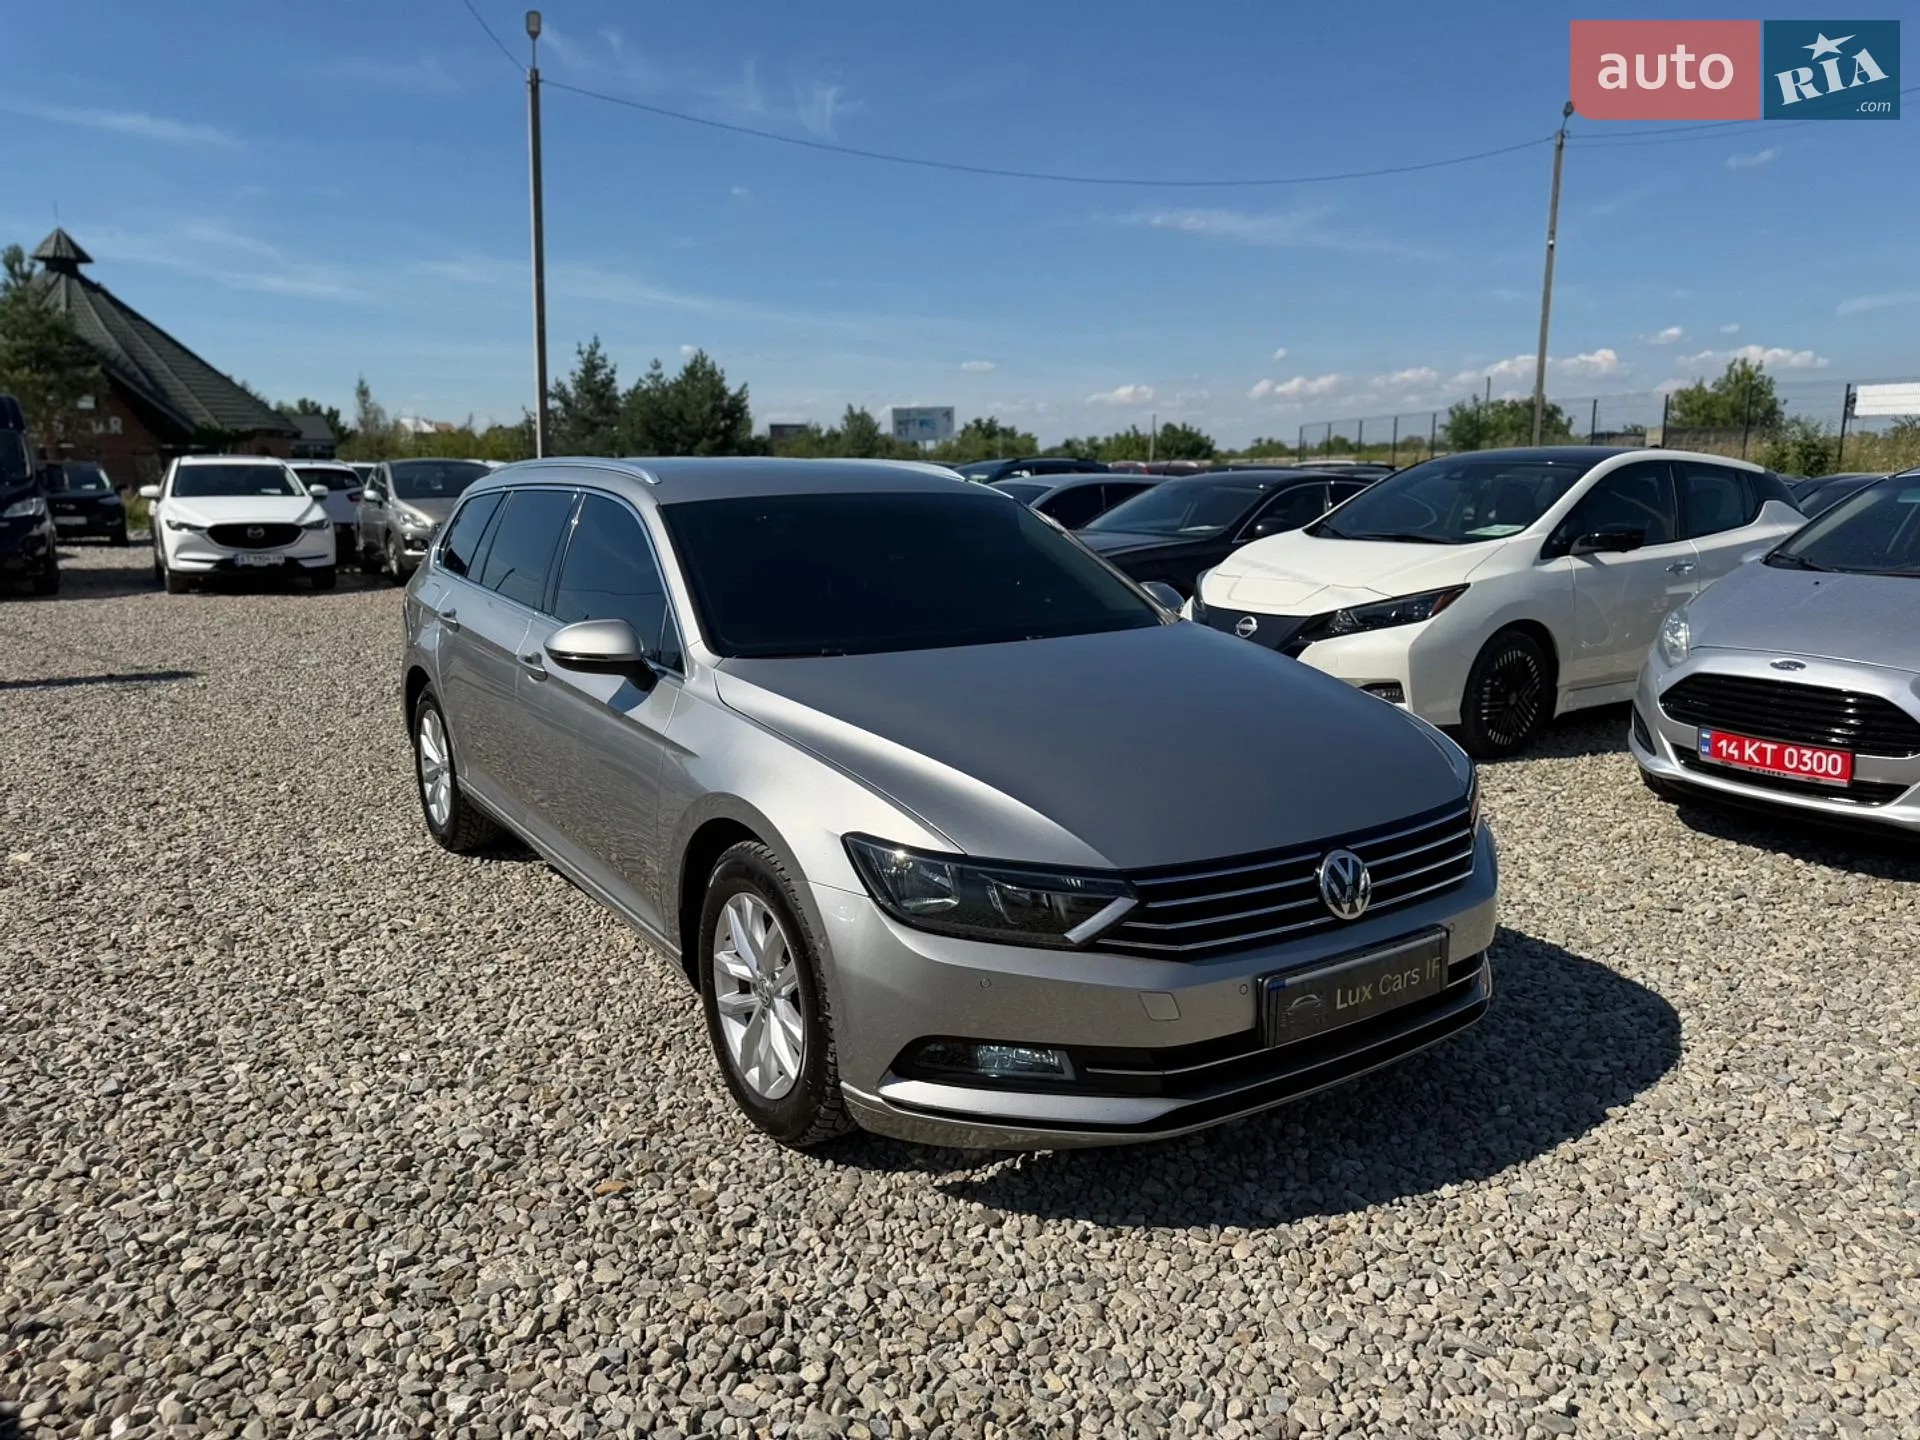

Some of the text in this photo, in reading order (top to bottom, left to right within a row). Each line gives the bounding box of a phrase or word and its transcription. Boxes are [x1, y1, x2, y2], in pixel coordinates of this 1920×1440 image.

[1717, 739, 1739, 760] 14
[1744, 739, 1778, 766] KT
[1784, 747, 1842, 775] 0300
[1336, 983, 1373, 1010] Lux
[1379, 967, 1420, 996] Cars
